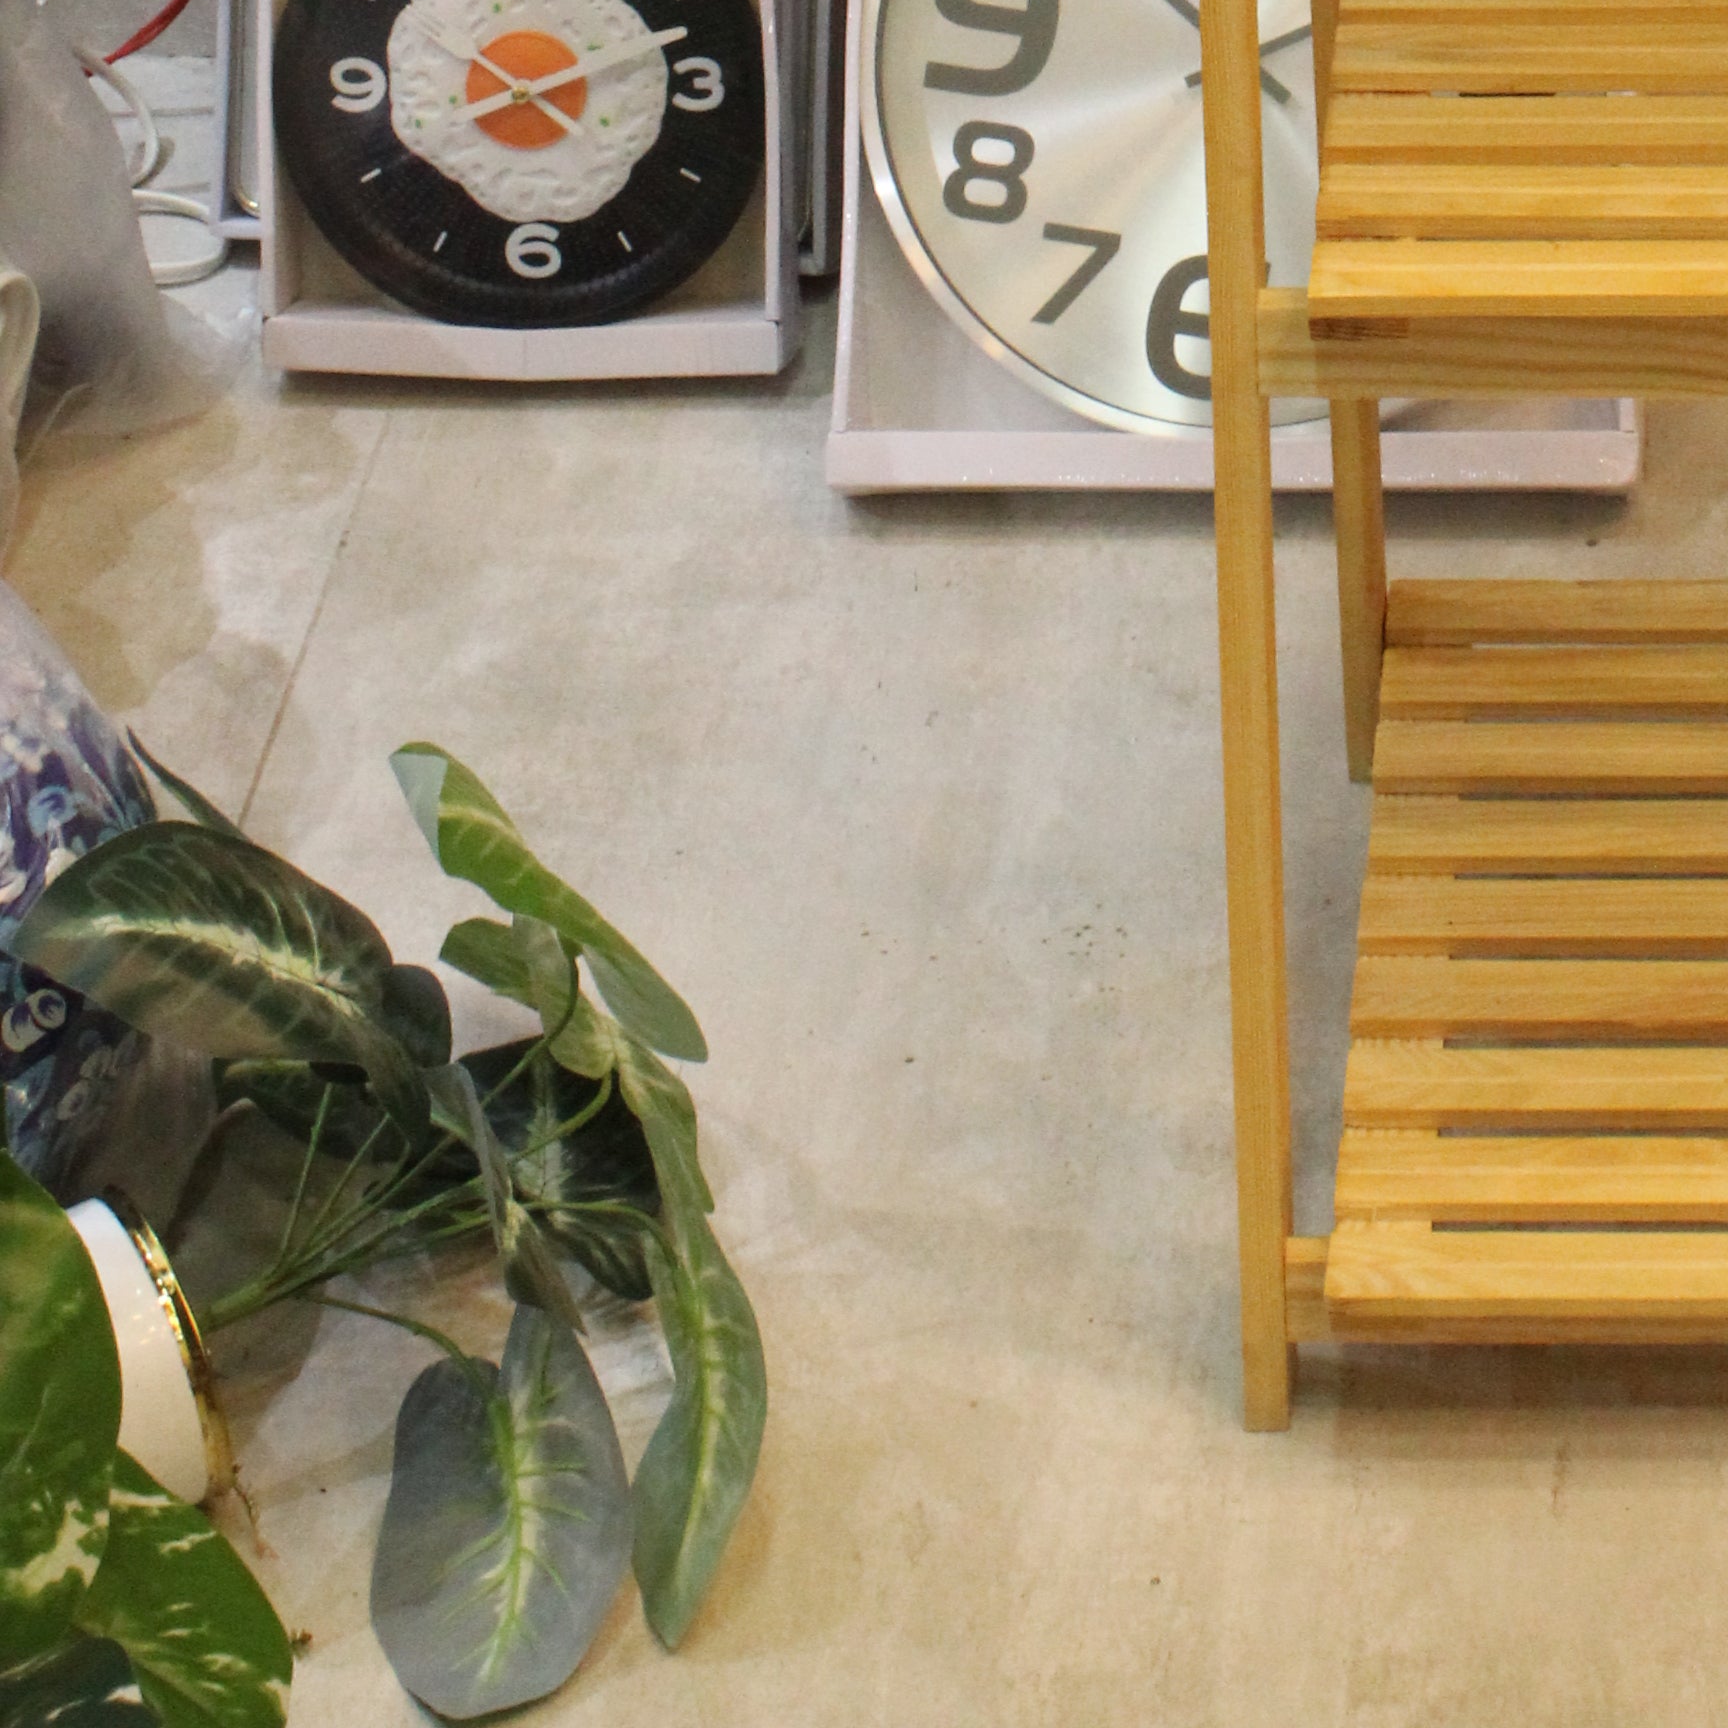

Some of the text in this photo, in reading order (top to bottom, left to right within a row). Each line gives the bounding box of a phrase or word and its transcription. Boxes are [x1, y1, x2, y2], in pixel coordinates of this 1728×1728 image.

[329, 56, 389, 114] 9
[672, 56, 726, 113] 3
[942, 120, 1035, 224] 8
[504, 222, 562, 280] 6
[1030, 221, 1121, 326] 7
